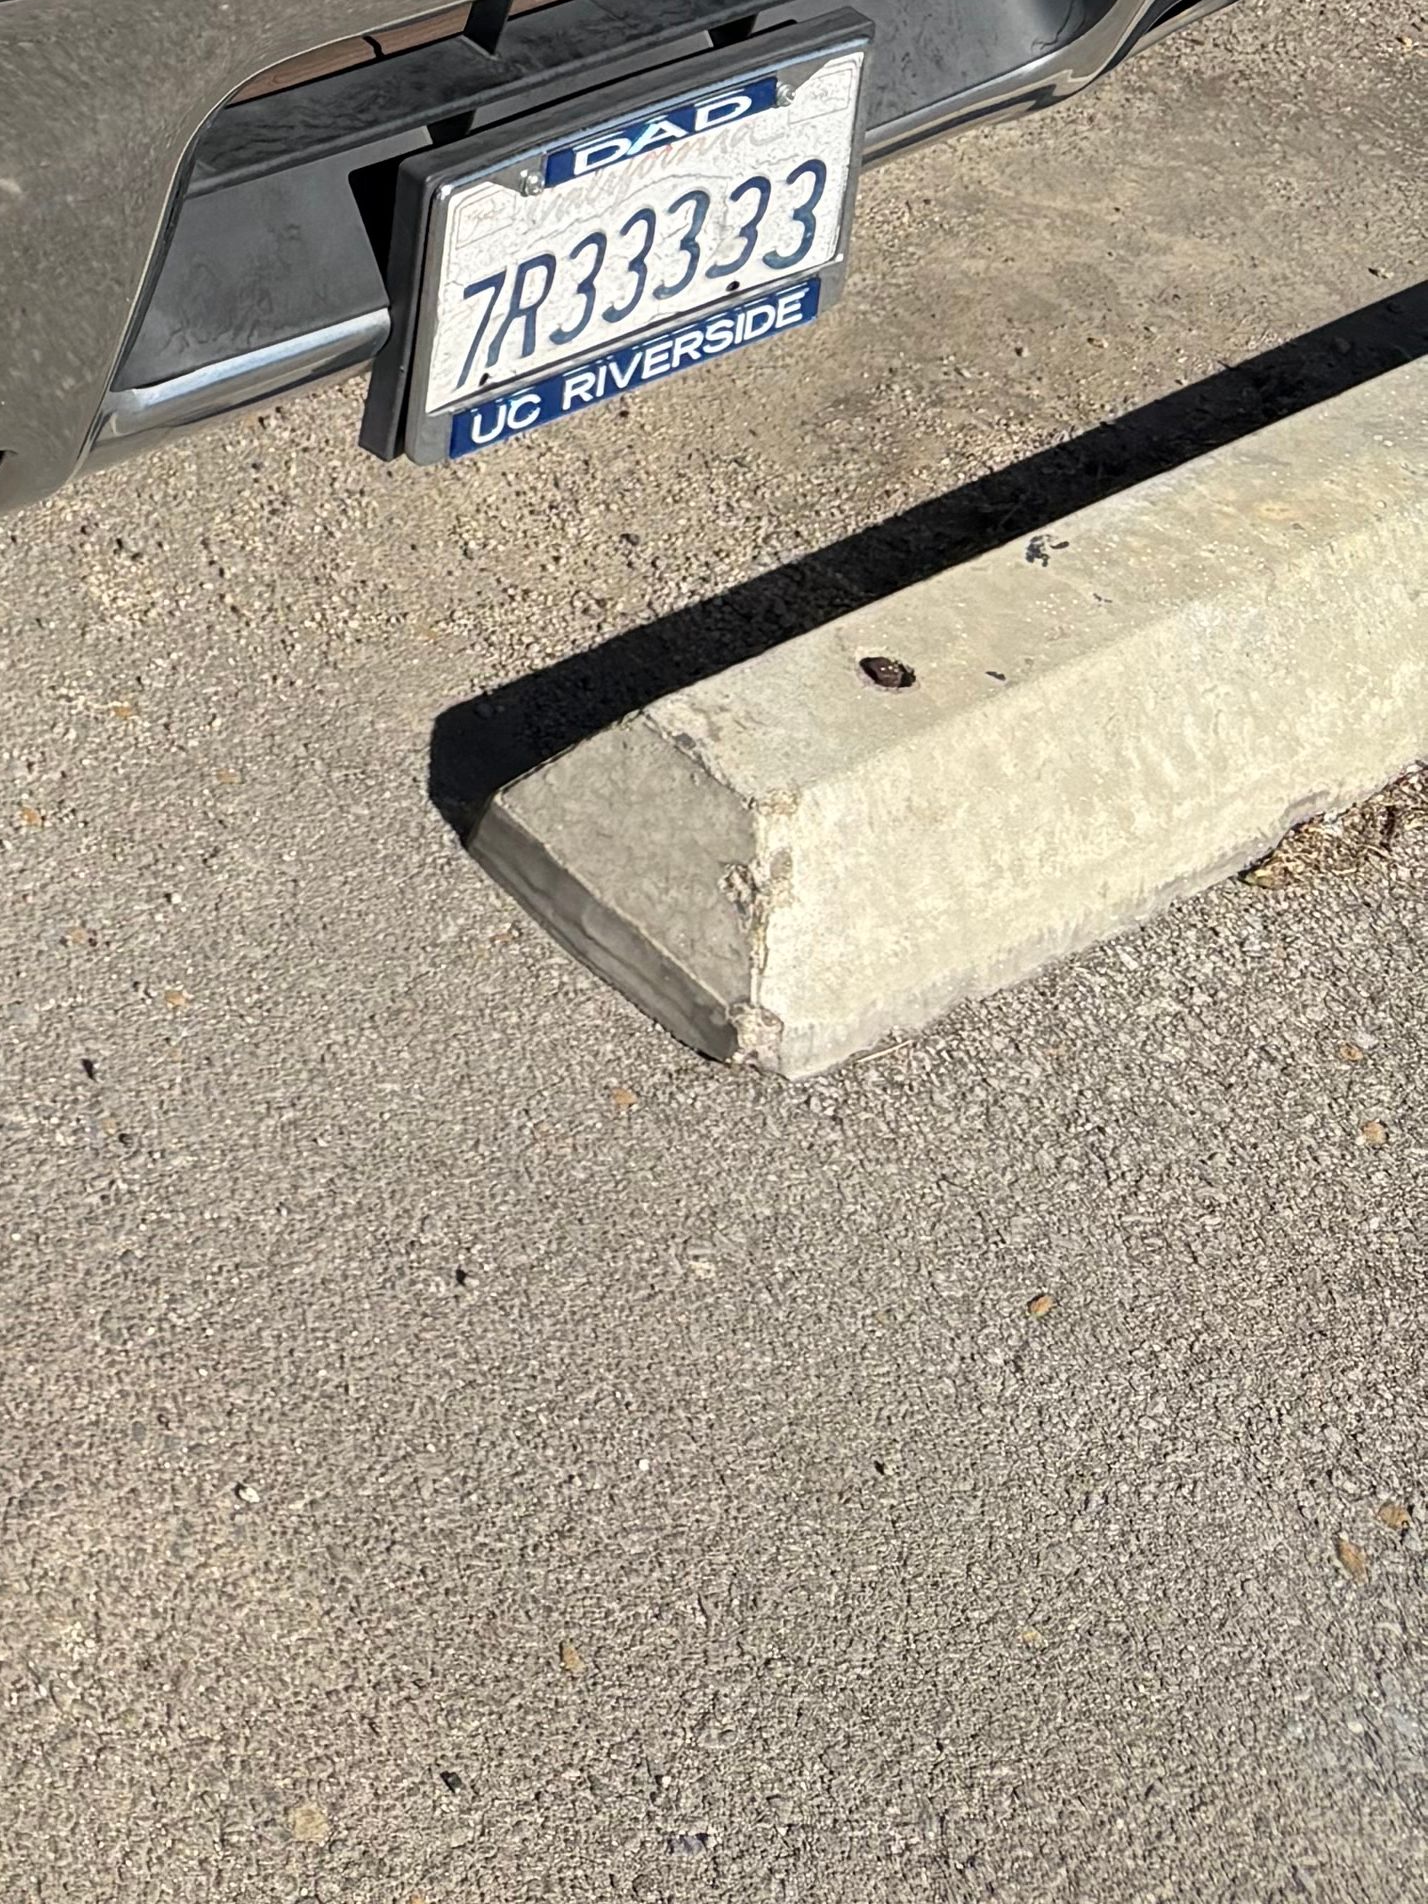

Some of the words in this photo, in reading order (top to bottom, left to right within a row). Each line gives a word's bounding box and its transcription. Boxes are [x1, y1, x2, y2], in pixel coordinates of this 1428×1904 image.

[573, 95, 753, 175] DAD
[456, 158, 828, 391] 7R33333
[471, 394, 541, 443] UC
[562, 295, 803, 410] RIVERSIDE
